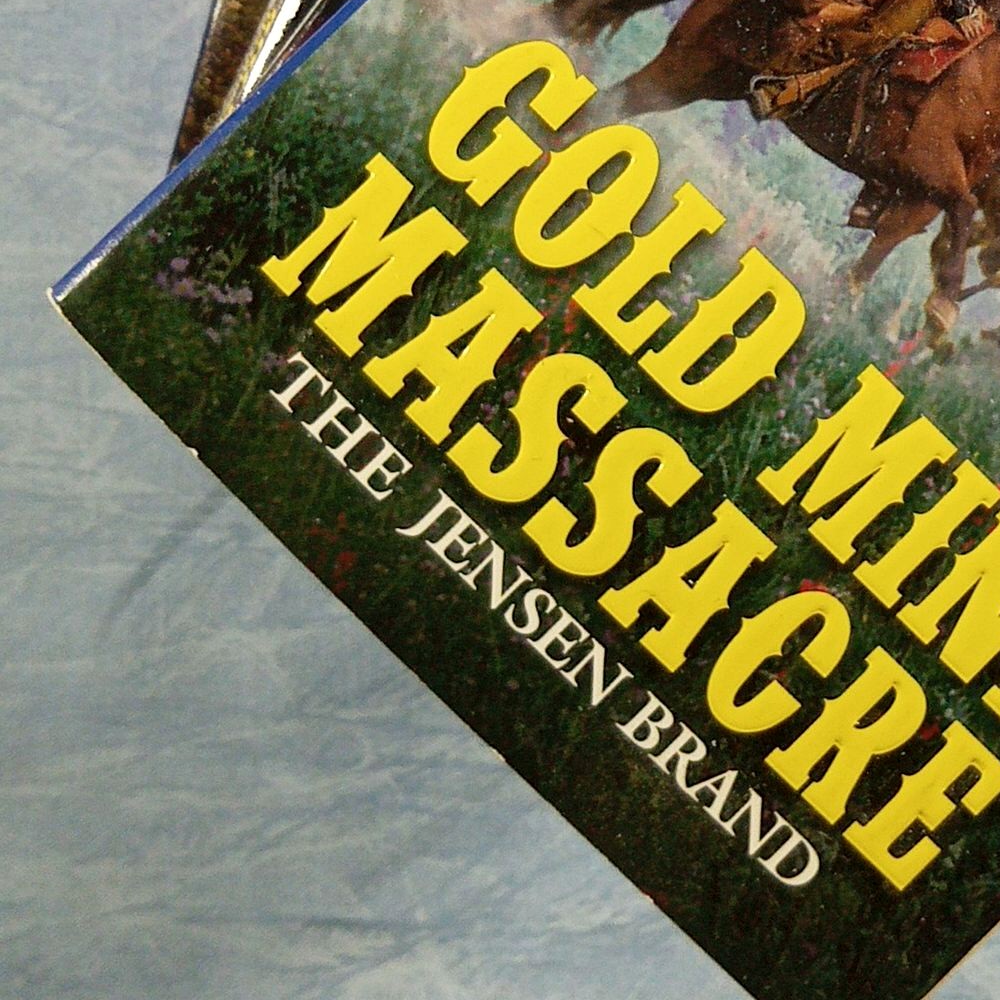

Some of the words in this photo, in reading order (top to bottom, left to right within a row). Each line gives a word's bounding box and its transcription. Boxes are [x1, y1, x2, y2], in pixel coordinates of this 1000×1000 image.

[427, 40, 807, 413] GOLD
[269, 351, 413, 500] THE
[395, 488, 634, 706] JENSEN
[616, 691, 820, 887] BRAND
